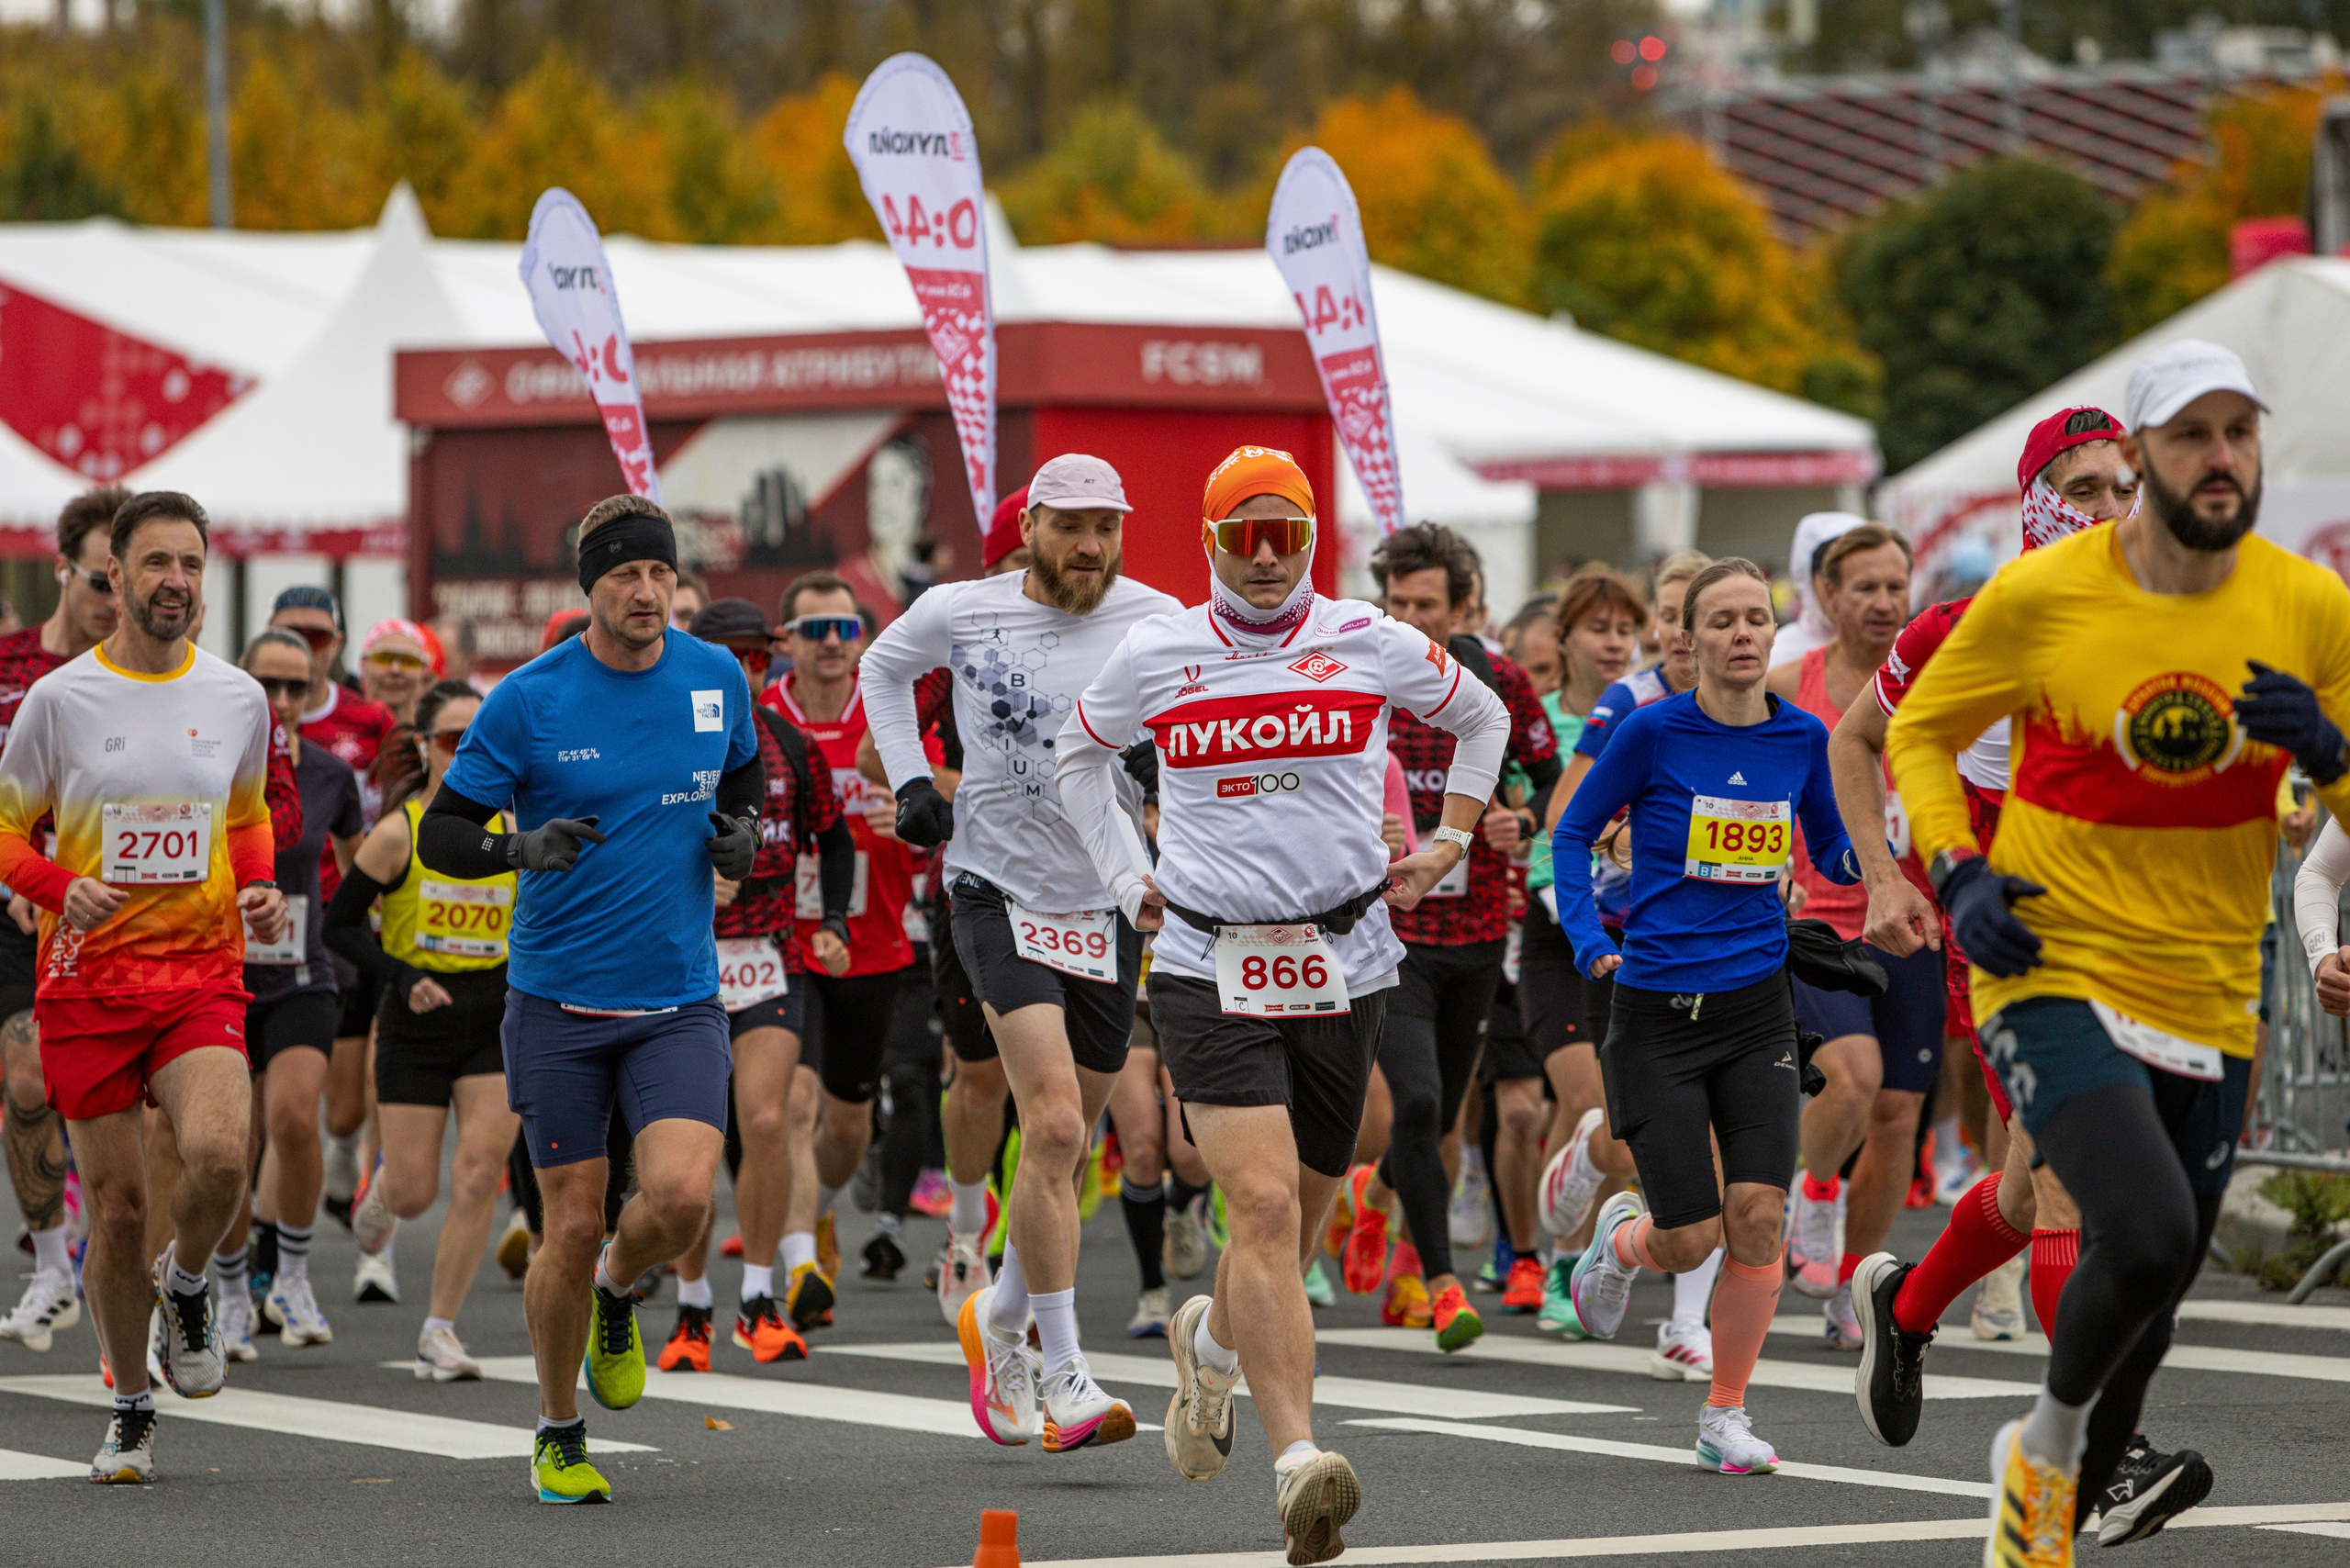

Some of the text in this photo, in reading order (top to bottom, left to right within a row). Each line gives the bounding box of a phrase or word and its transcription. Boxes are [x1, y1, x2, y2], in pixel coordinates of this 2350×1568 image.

[1340, 620, 1369, 632] MELKE
[1175, 685, 1210, 699] JÖGEL
[1168, 703, 1351, 758] ЛУКОЙЛ
[692, 770, 721, 782] NEVER
[1221, 772, 1300, 795] ЭКТО 100
[118, 830, 197, 859] 2701
[1706, 821, 1783, 853] 1893
[427, 902, 502, 932] 2070
[1020, 922, 1107, 959] 2369
[720, 960, 777, 989] 402
[1242, 955, 1327, 991] 866
